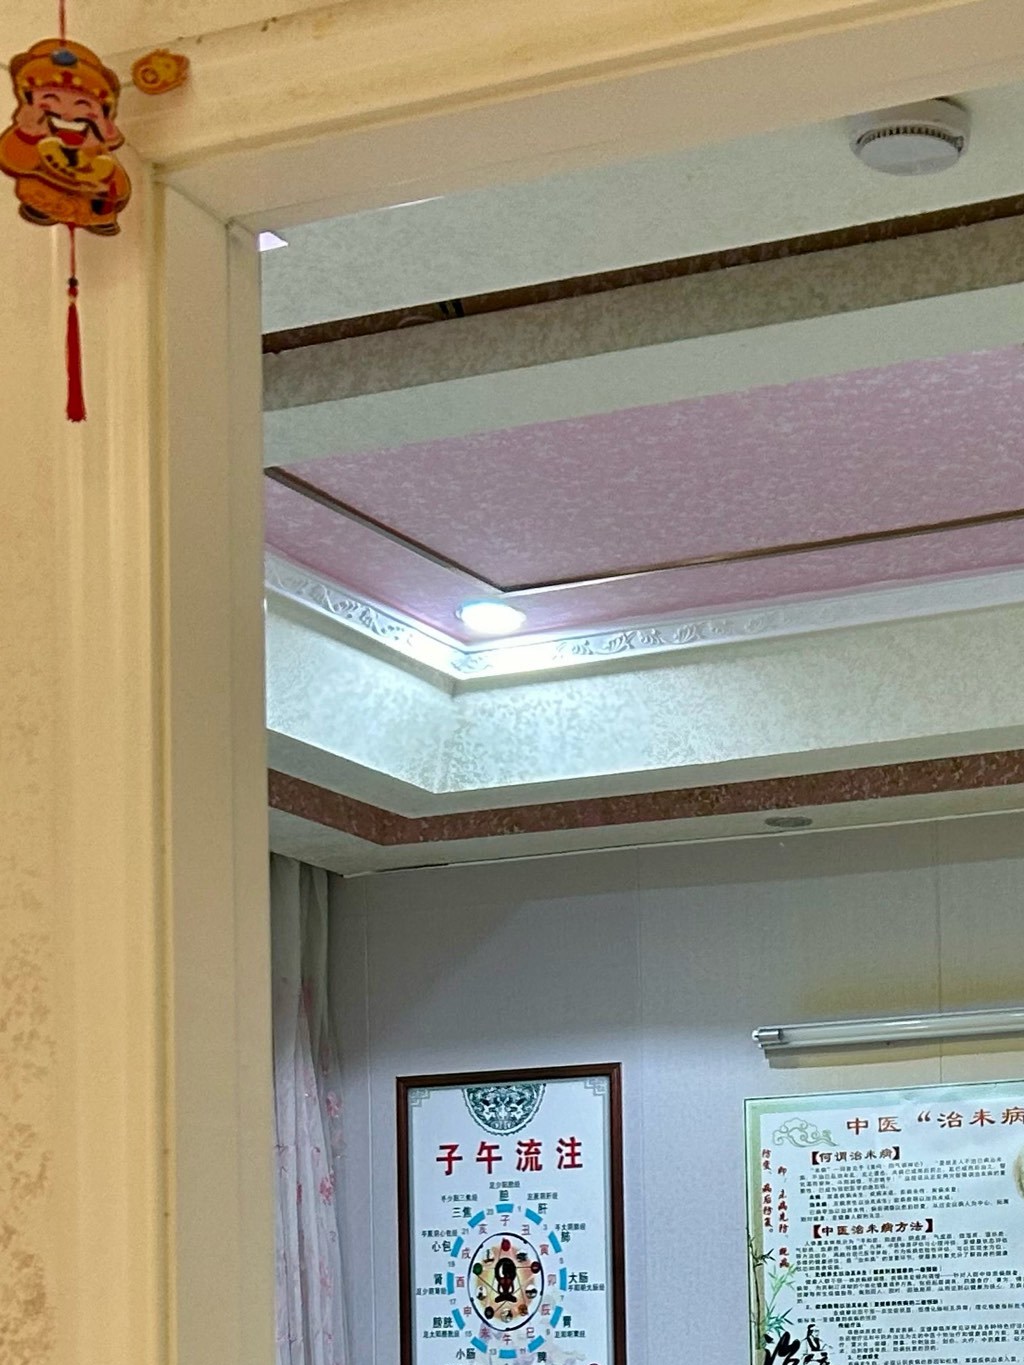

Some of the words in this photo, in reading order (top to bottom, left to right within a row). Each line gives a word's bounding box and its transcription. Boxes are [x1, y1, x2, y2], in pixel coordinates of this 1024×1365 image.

[436, 1136, 583, 1176] 子午流注
[452, 1206, 472, 1219] 三焦
[500, 1215, 510, 1226] 子
[521, 1225, 531, 1236] 丑
[432, 1240, 452, 1253] 心包
[568, 1272, 589, 1284] 大肠
[502, 1332, 512, 1344] 午
[456, 1348, 476, 1361] 小肠
